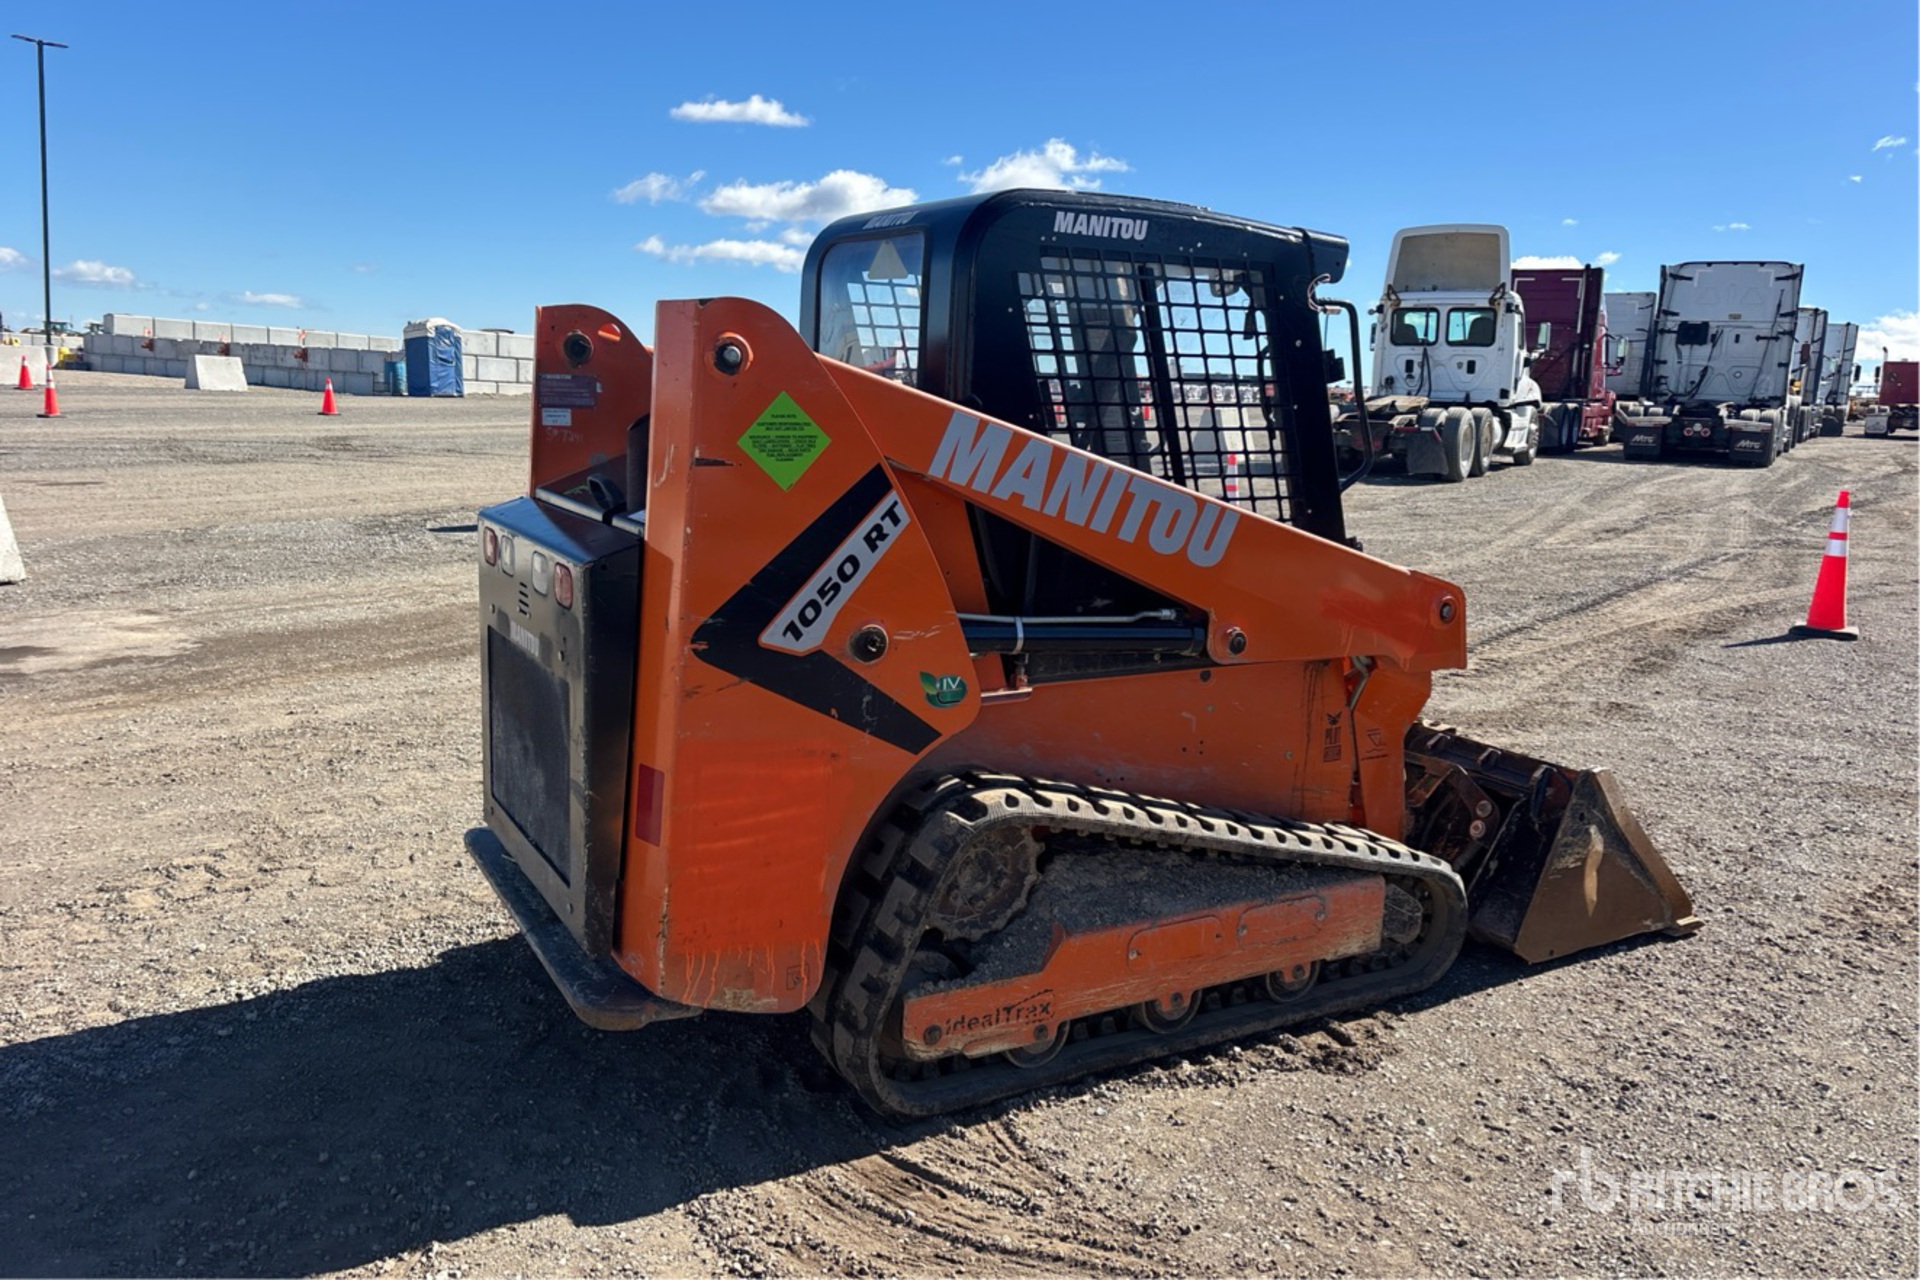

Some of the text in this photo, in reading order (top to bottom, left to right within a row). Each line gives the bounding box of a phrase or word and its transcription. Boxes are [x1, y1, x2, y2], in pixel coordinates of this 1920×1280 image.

[1053, 211, 1149, 241] MANITOU
[928, 409, 1241, 568] MANITOU
[782, 500, 902, 642] 1050 RT
